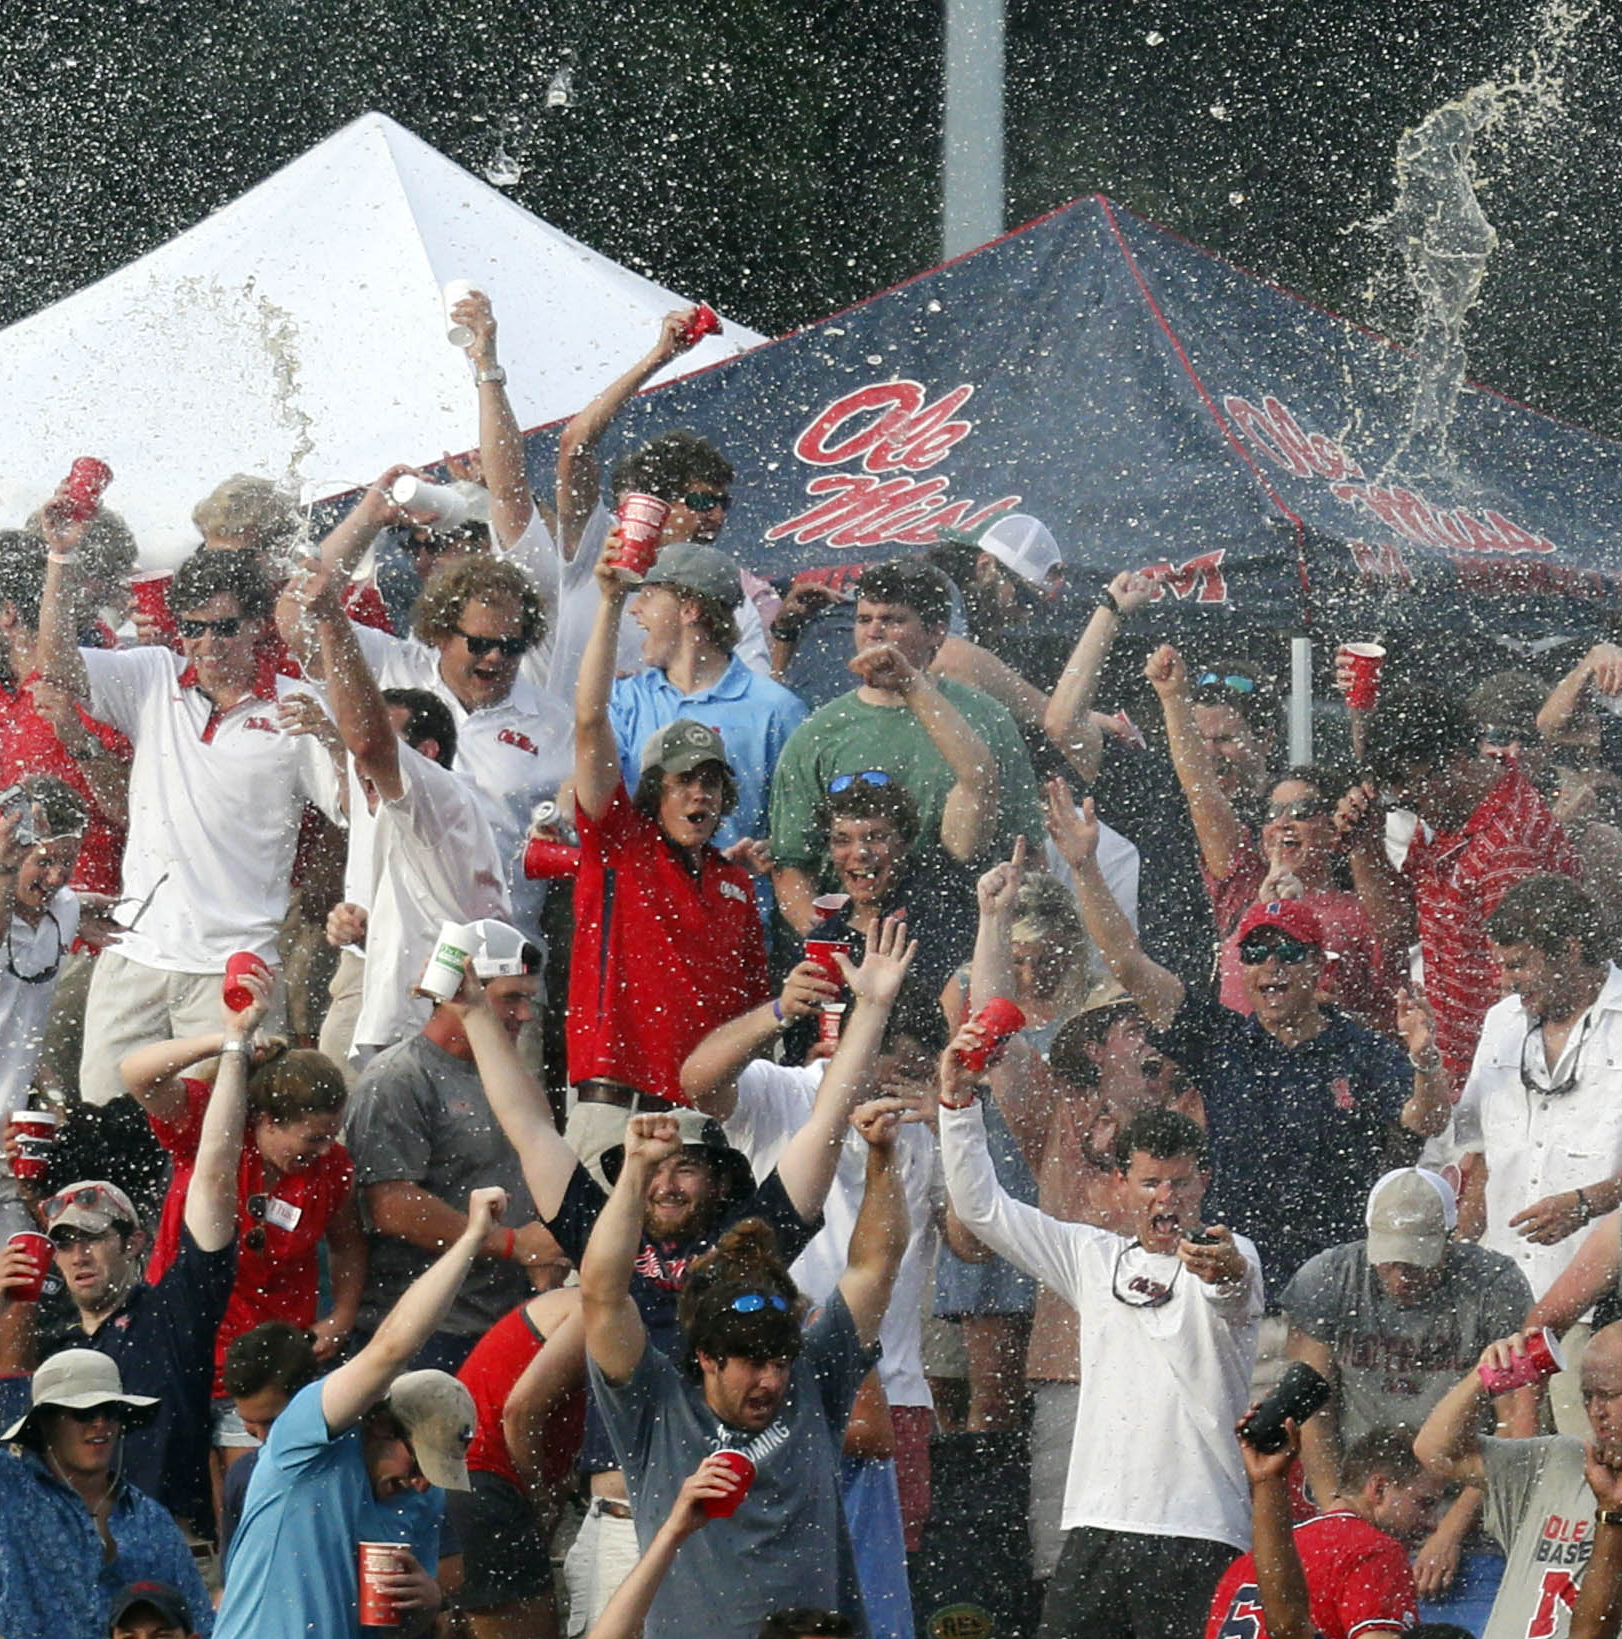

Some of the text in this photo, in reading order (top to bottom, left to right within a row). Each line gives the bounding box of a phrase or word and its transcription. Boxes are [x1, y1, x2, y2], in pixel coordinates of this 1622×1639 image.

[794, 379, 974, 474] Ole
[1224, 396, 1366, 479] Ole
[1330, 482, 1556, 555] Miss
[1543, 1514, 1589, 1543] OLE
